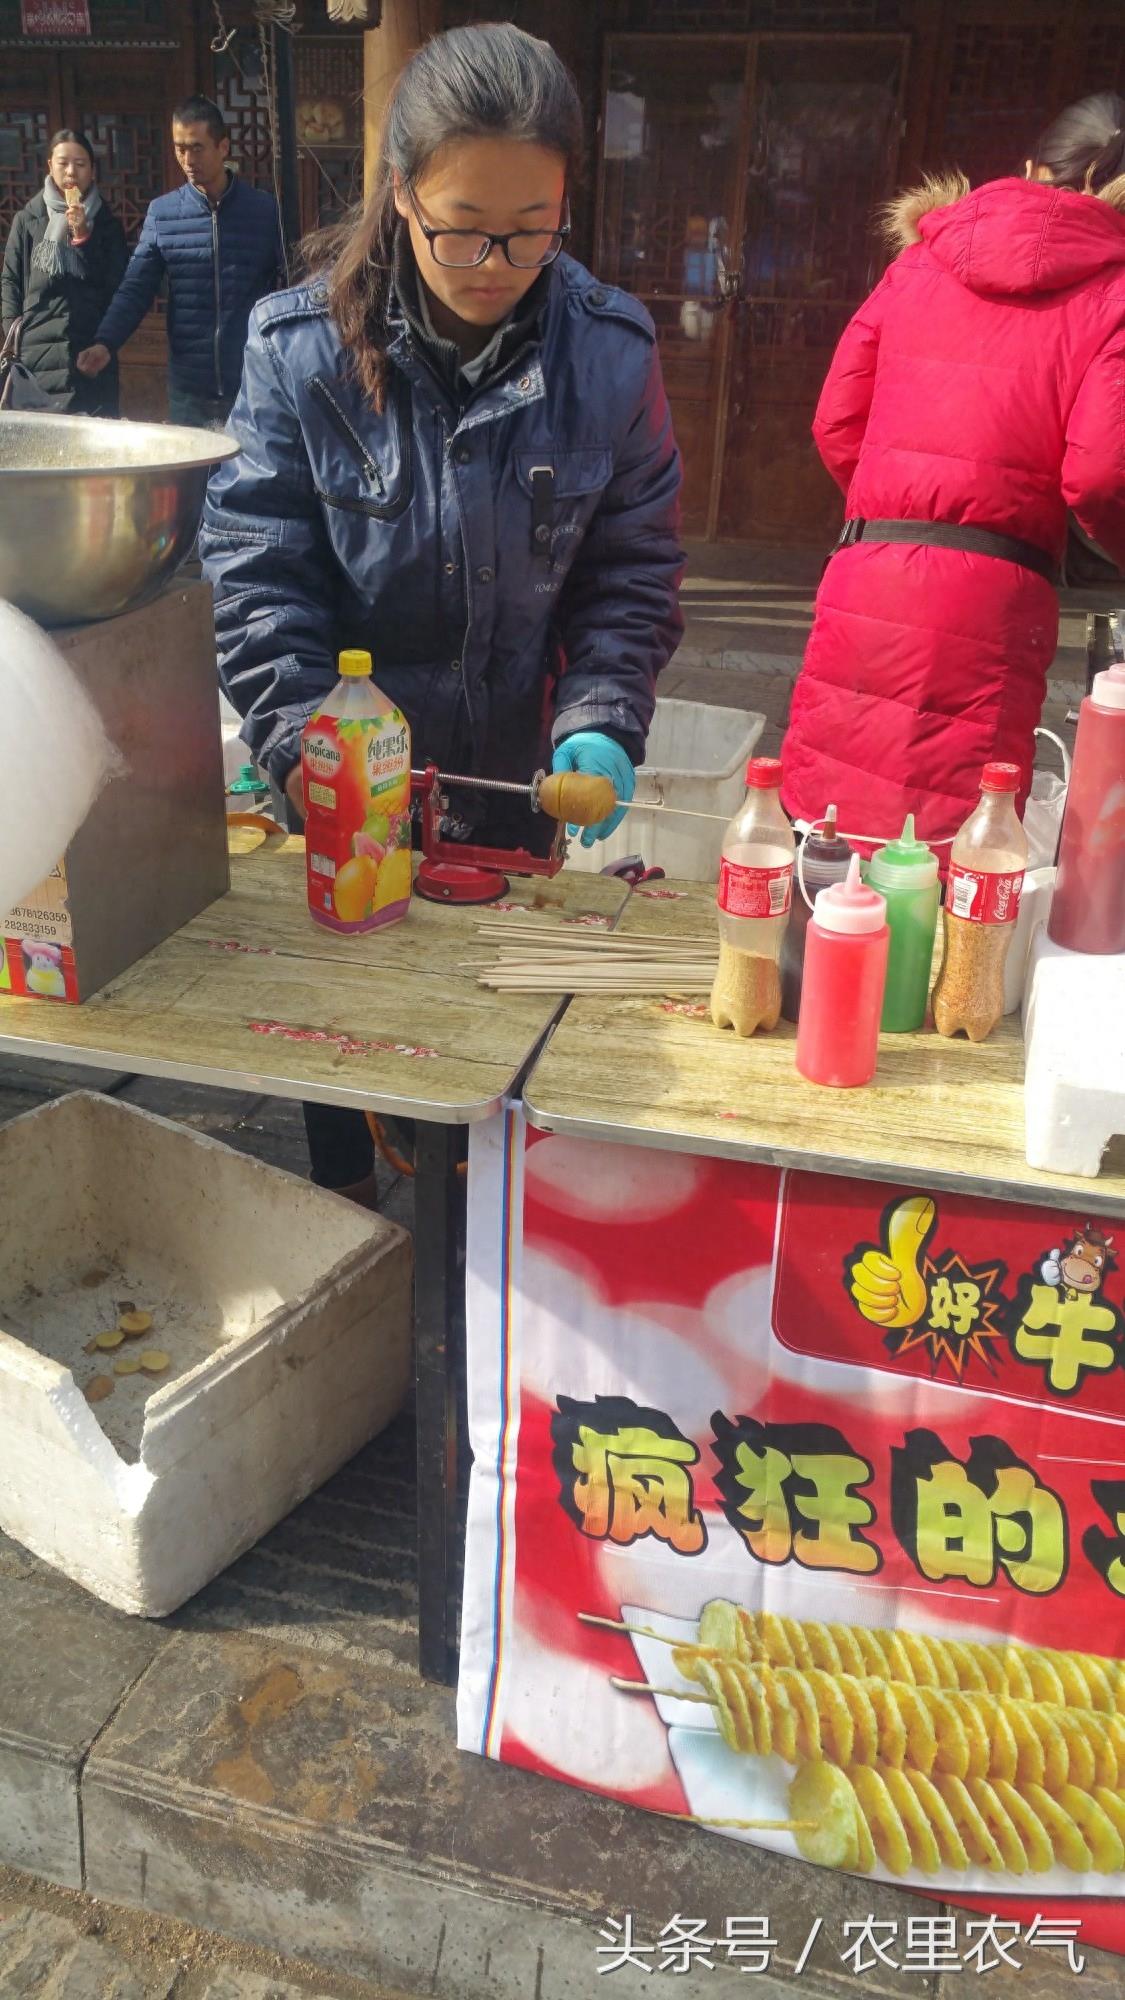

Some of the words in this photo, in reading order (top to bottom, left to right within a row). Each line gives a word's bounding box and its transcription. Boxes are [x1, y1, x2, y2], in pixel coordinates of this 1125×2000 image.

[303, 740, 341, 762] Tropicana
[367, 728, 408, 762] 纯果乐
[4, 920, 56, 935] 282833159
[928, 1277, 981, 1335] 好
[1015, 1284, 1117, 1391] 牛
[571, 1423, 1125, 1594] 疯狂的
